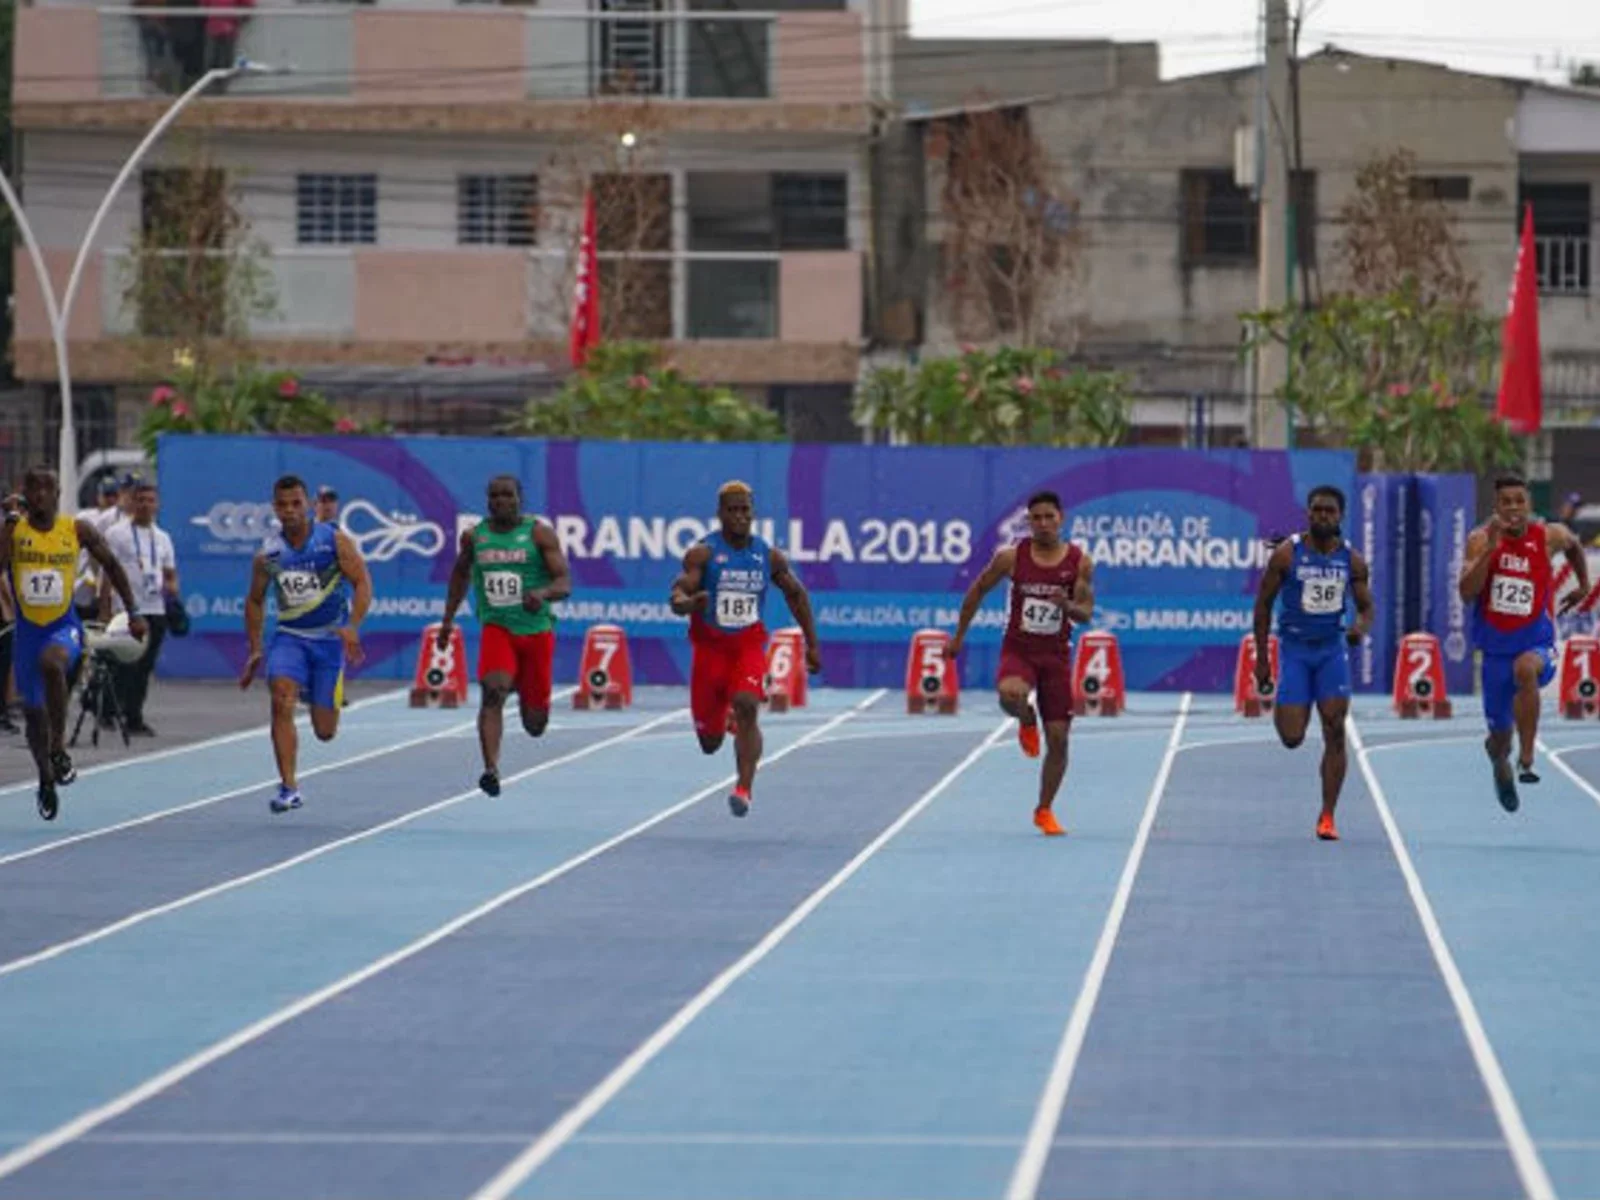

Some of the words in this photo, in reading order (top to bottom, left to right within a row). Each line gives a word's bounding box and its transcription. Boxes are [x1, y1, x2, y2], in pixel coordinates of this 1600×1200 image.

[1182, 517, 1211, 538] DE
[1071, 539, 1274, 570] ARRANQUI
[30, 574, 55, 595] 17
[485, 577, 518, 596] 419
[1311, 584, 1337, 603] 36
[1494, 582, 1532, 604] 125
[723, 597, 756, 617] 187
[594, 642, 618, 672] 7
[771, 645, 793, 679] 6
[921, 645, 945, 678] 5
[1085, 648, 1111, 684] 4
[1408, 650, 1433, 687] 2
[1573, 652, 1592, 682] 1
